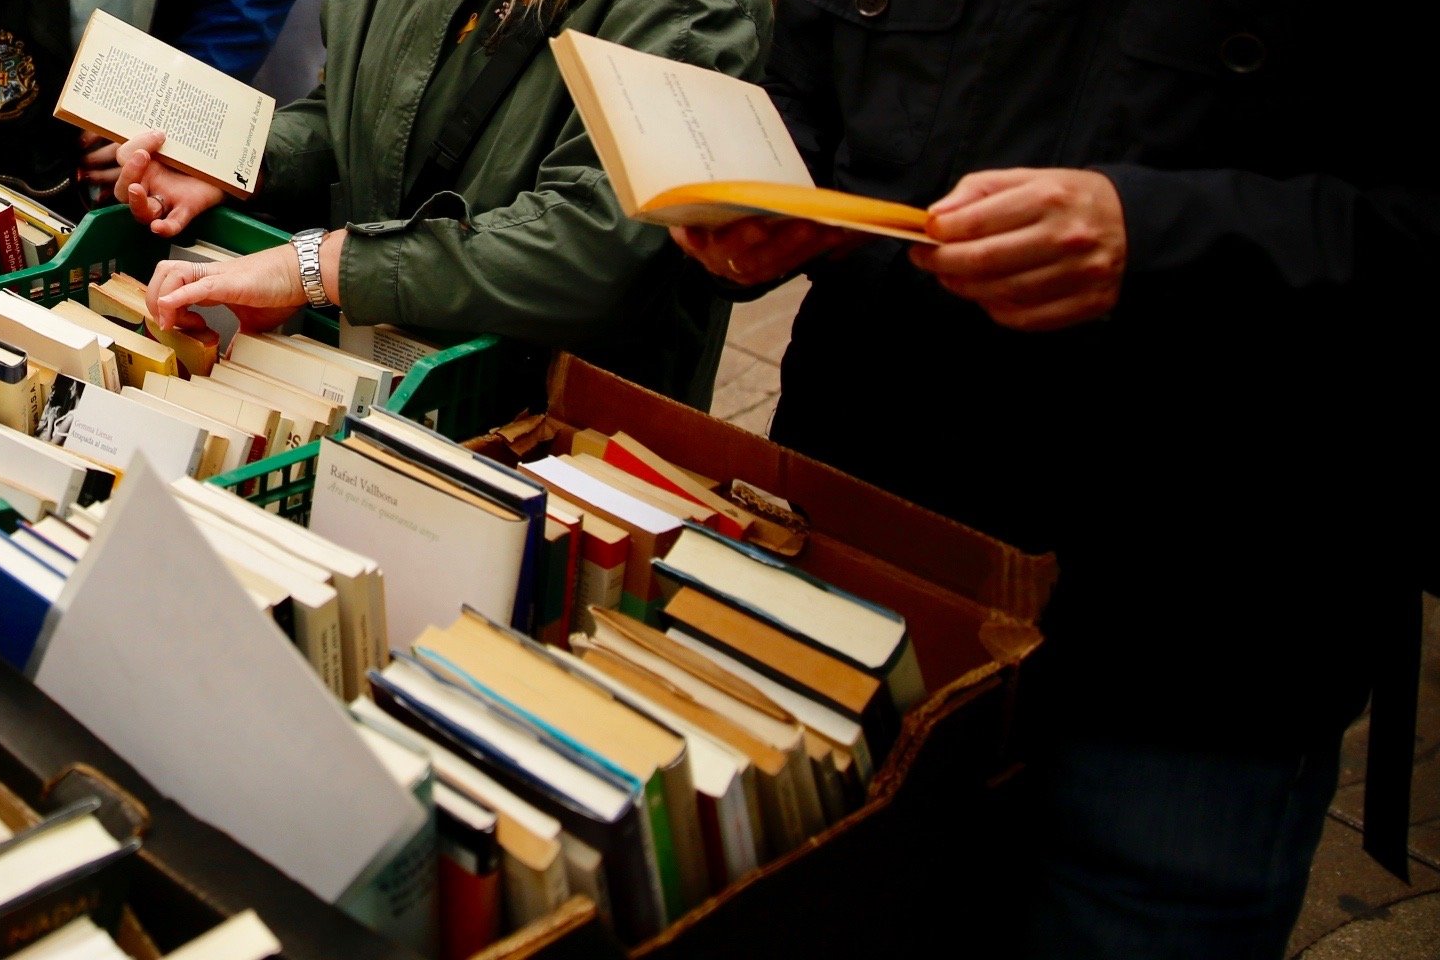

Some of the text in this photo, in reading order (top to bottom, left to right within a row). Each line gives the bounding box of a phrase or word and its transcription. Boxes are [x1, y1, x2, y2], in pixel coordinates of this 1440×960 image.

[72, 62, 90, 95] MERCÈ
[83, 52, 105, 100] RODOREDA
[155, 72, 170, 99] Cristina
[151, 96, 162, 117] meva
[3, 230, 12, 253] Torres
[329, 464, 398, 507] Rafael Vallbona
